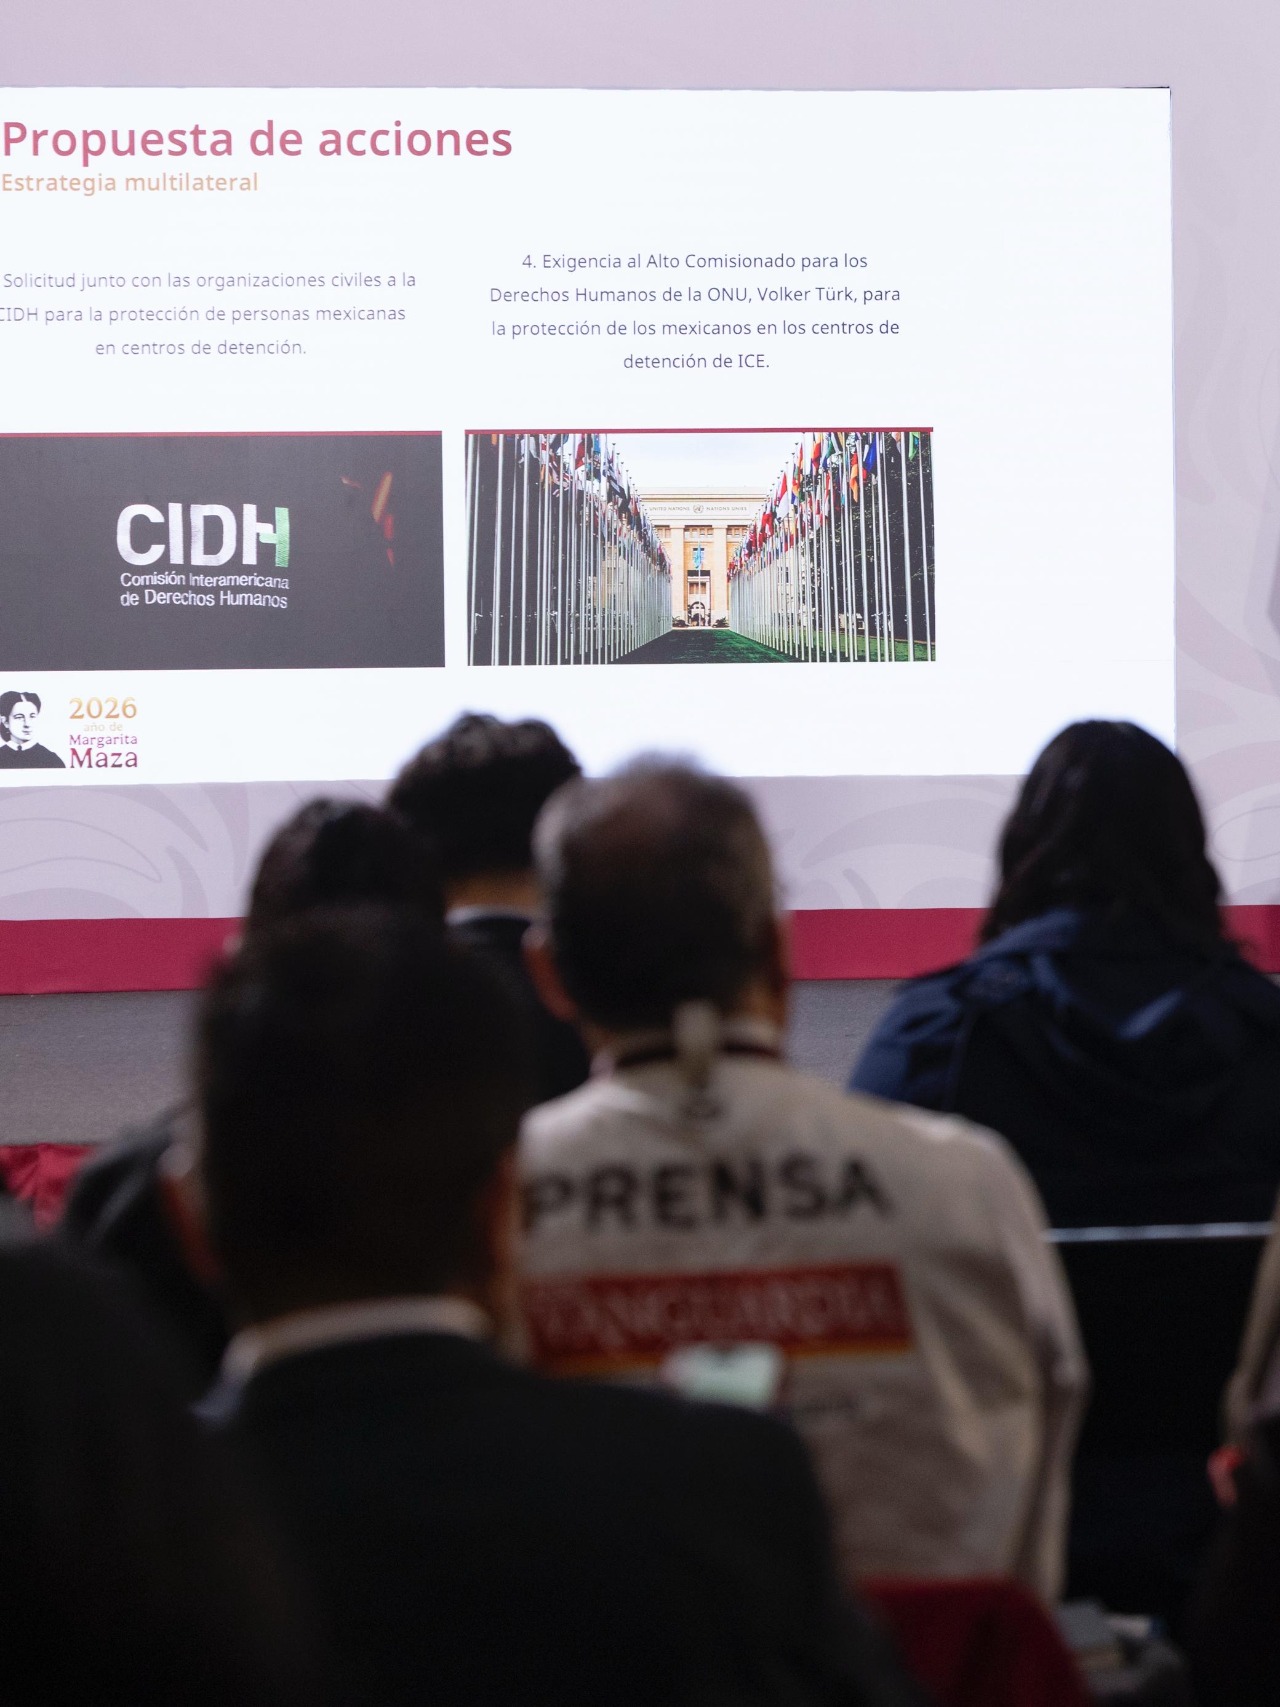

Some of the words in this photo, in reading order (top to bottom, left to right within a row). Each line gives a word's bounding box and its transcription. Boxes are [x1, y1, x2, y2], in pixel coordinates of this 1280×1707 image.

[3, 121, 233, 168] Propuesta
[249, 119, 303, 157] de
[318, 119, 513, 157] acciones
[2, 172, 116, 197] Estrategia
[125, 172, 258, 192] multilateral
[521, 254, 537, 269] 4.
[542, 253, 622, 273] Exigencia
[627, 253, 641, 269] al
[645, 252, 680, 269] Alto
[684, 252, 796, 269] Comisionado
[801, 256, 839, 273] para
[844, 252, 868, 268] los
[3, 272, 76, 288] Solicitud
[79, 272, 127, 292] junto
[131, 275, 162, 288] con
[167, 271, 191, 288] las
[196, 272, 326, 292] organizaciones
[331, 271, 382, 288] civiles
[386, 275, 397, 287] a
[402, 271, 416, 287] la
[490, 286, 570, 303] Derechos
[575, 287, 657, 302] Humanos
[662, 286, 683, 302] de
[688, 286, 702, 302] la
[707, 287, 752, 305] ONU,
[756, 285, 812, 302] Volker
[814, 286, 858, 305] Türk,
[863, 289, 901, 306] para
[44, 309, 83, 326] para
[89, 305, 103, 322] la
[108, 305, 200, 326] protección
[205, 305, 227, 321] de
[231, 309, 310, 325] personas
[315, 305, 406, 321] mexicanas
[492, 320, 506, 336] la
[511, 319, 601, 340] protección
[606, 319, 628, 336] de
[633, 319, 657, 336] los
[661, 320, 752, 336] mexicanos
[756, 323, 778, 335] en
[782, 319, 807, 335] los
[811, 321, 874, 335] centros
[878, 319, 900, 335] de
[95, 343, 116, 356] en
[121, 341, 186, 356] centros
[190, 339, 212, 355] de
[217, 338, 307, 355] detención.
[623, 352, 707, 369] detención
[712, 352, 733, 369] de
[737, 353, 770, 369] ICE.
[116, 502, 291, 568] CIDH
[120, 570, 186, 587] Comisión
[189, 572, 290, 590] Interamericana
[120, 590, 140, 607] de
[144, 589, 216, 607] Derechos
[219, 589, 289, 609] Humanos
[69, 696, 138, 720] 2026
[83, 721, 106, 732] año
[108, 721, 123, 732] de
[69, 733, 138, 749] Margarita
[69, 747, 138, 769] Maza
[522, 1151, 893, 1232] PRENSA
